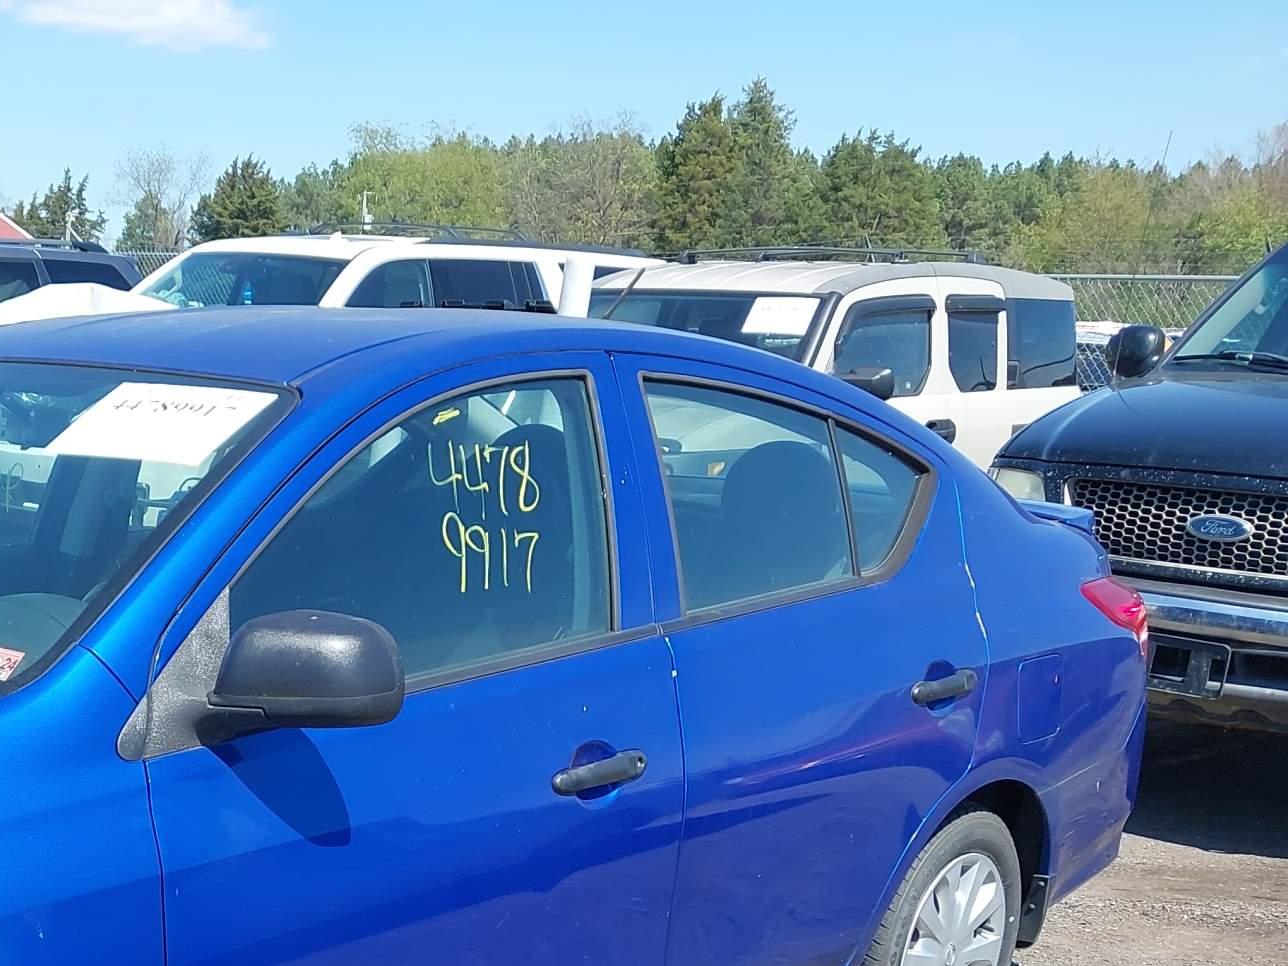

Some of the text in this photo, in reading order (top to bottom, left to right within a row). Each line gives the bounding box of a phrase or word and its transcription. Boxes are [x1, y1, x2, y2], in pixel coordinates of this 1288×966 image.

[427, 440, 541, 520] 4478
[1200, 519, 1236, 536] Ford
[441, 511, 540, 594] 9917
[0, 657, 19, 671] 24
